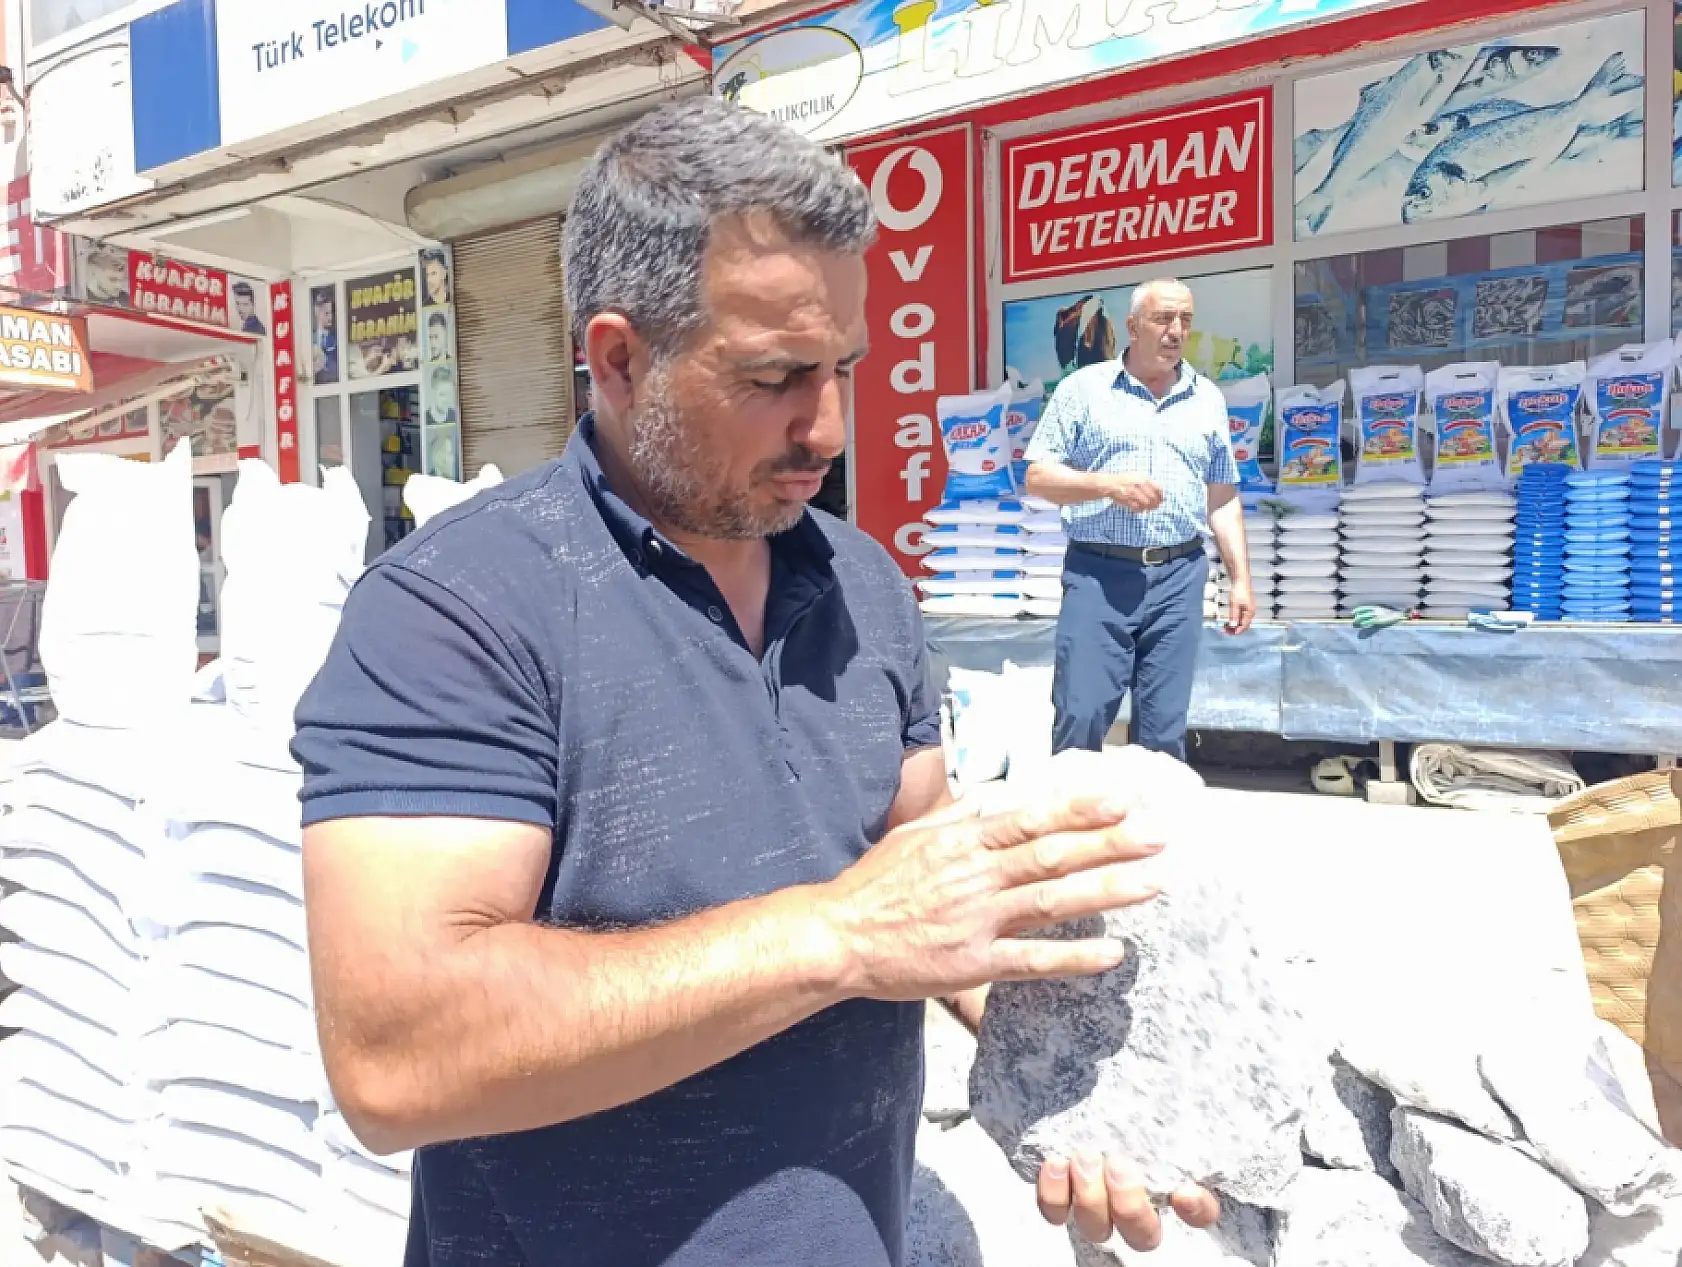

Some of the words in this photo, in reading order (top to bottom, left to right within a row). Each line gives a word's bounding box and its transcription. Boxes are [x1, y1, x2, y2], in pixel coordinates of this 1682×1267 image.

[252, 31, 304, 72] Türk
[311, 0, 425, 51] Telekom
[767, 93, 835, 122] ALIKÇILIK
[1018, 121, 1256, 210] DERMAN
[1029, 190, 1238, 256] VETERİNER
[134, 281, 227, 324] İBRAHİM
[135, 259, 224, 297] KUAFÖR
[0, 314, 73, 347] MAN
[0, 342, 82, 376] ASABI
[273, 292, 294, 449] KUAFÖR
[888, 246, 936, 601] vodafo
